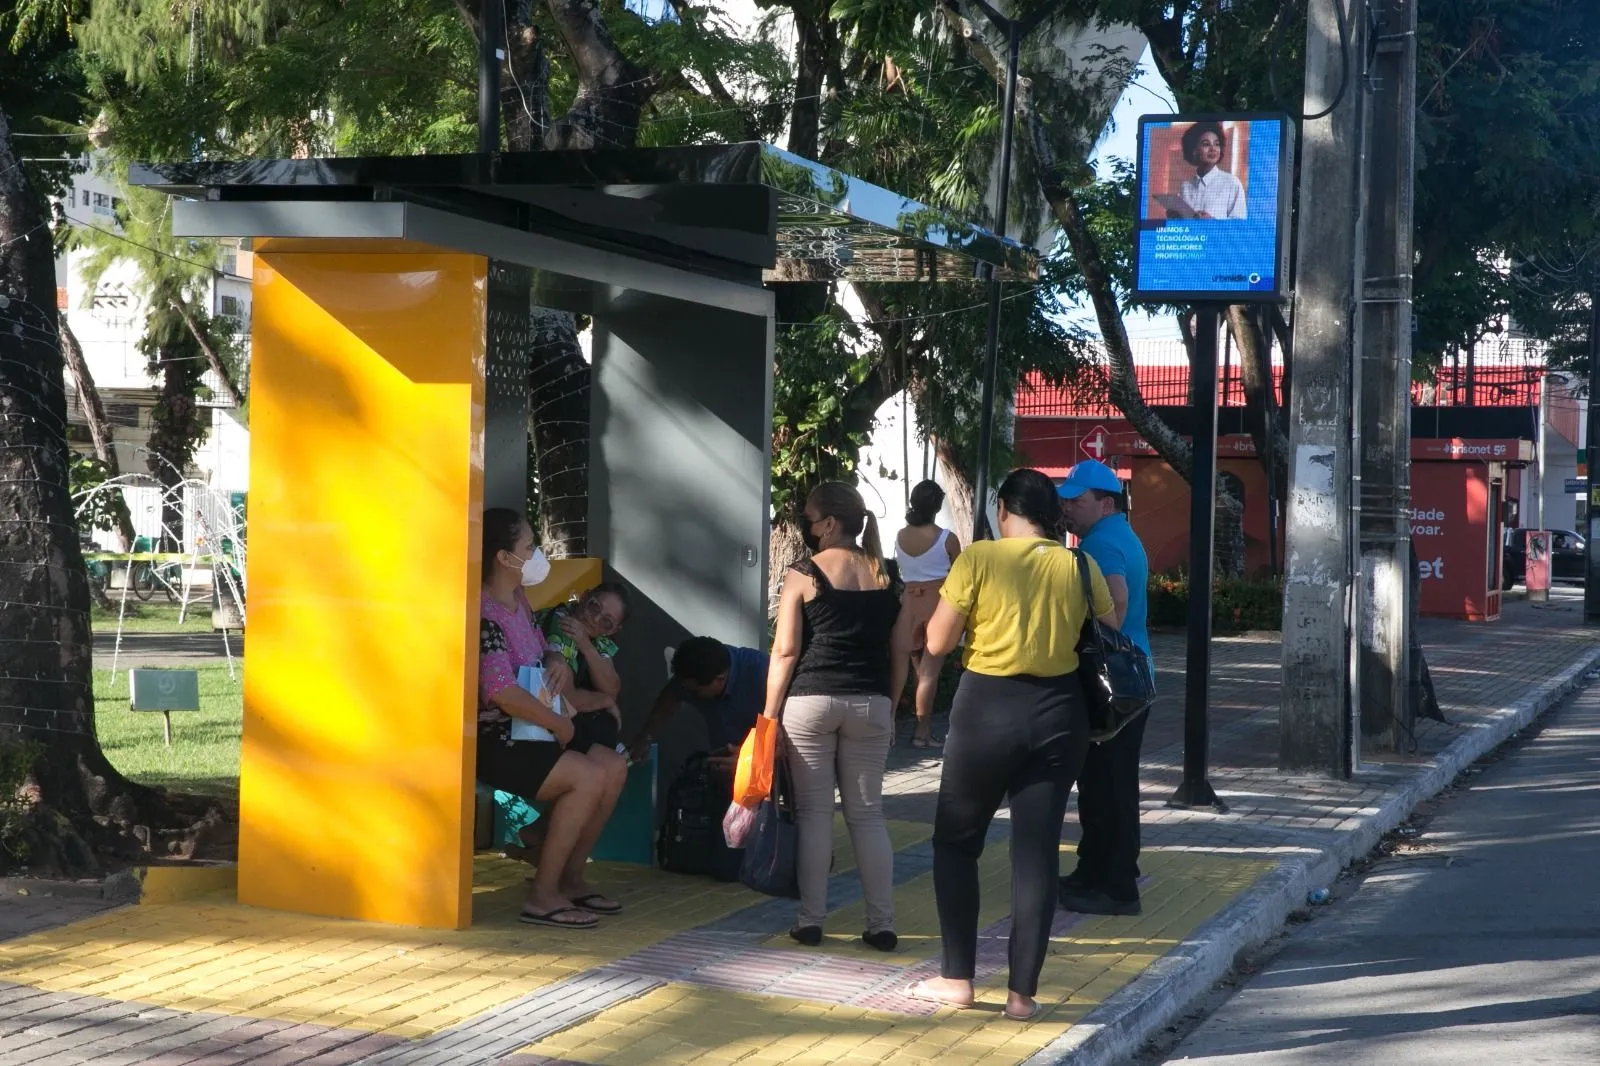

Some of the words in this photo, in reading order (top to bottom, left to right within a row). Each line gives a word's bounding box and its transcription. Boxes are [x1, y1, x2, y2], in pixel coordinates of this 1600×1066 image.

[1450, 443, 1491, 454] brisanet
[1494, 444, 1506, 455] 5G
[1408, 524, 1444, 536] voar.
